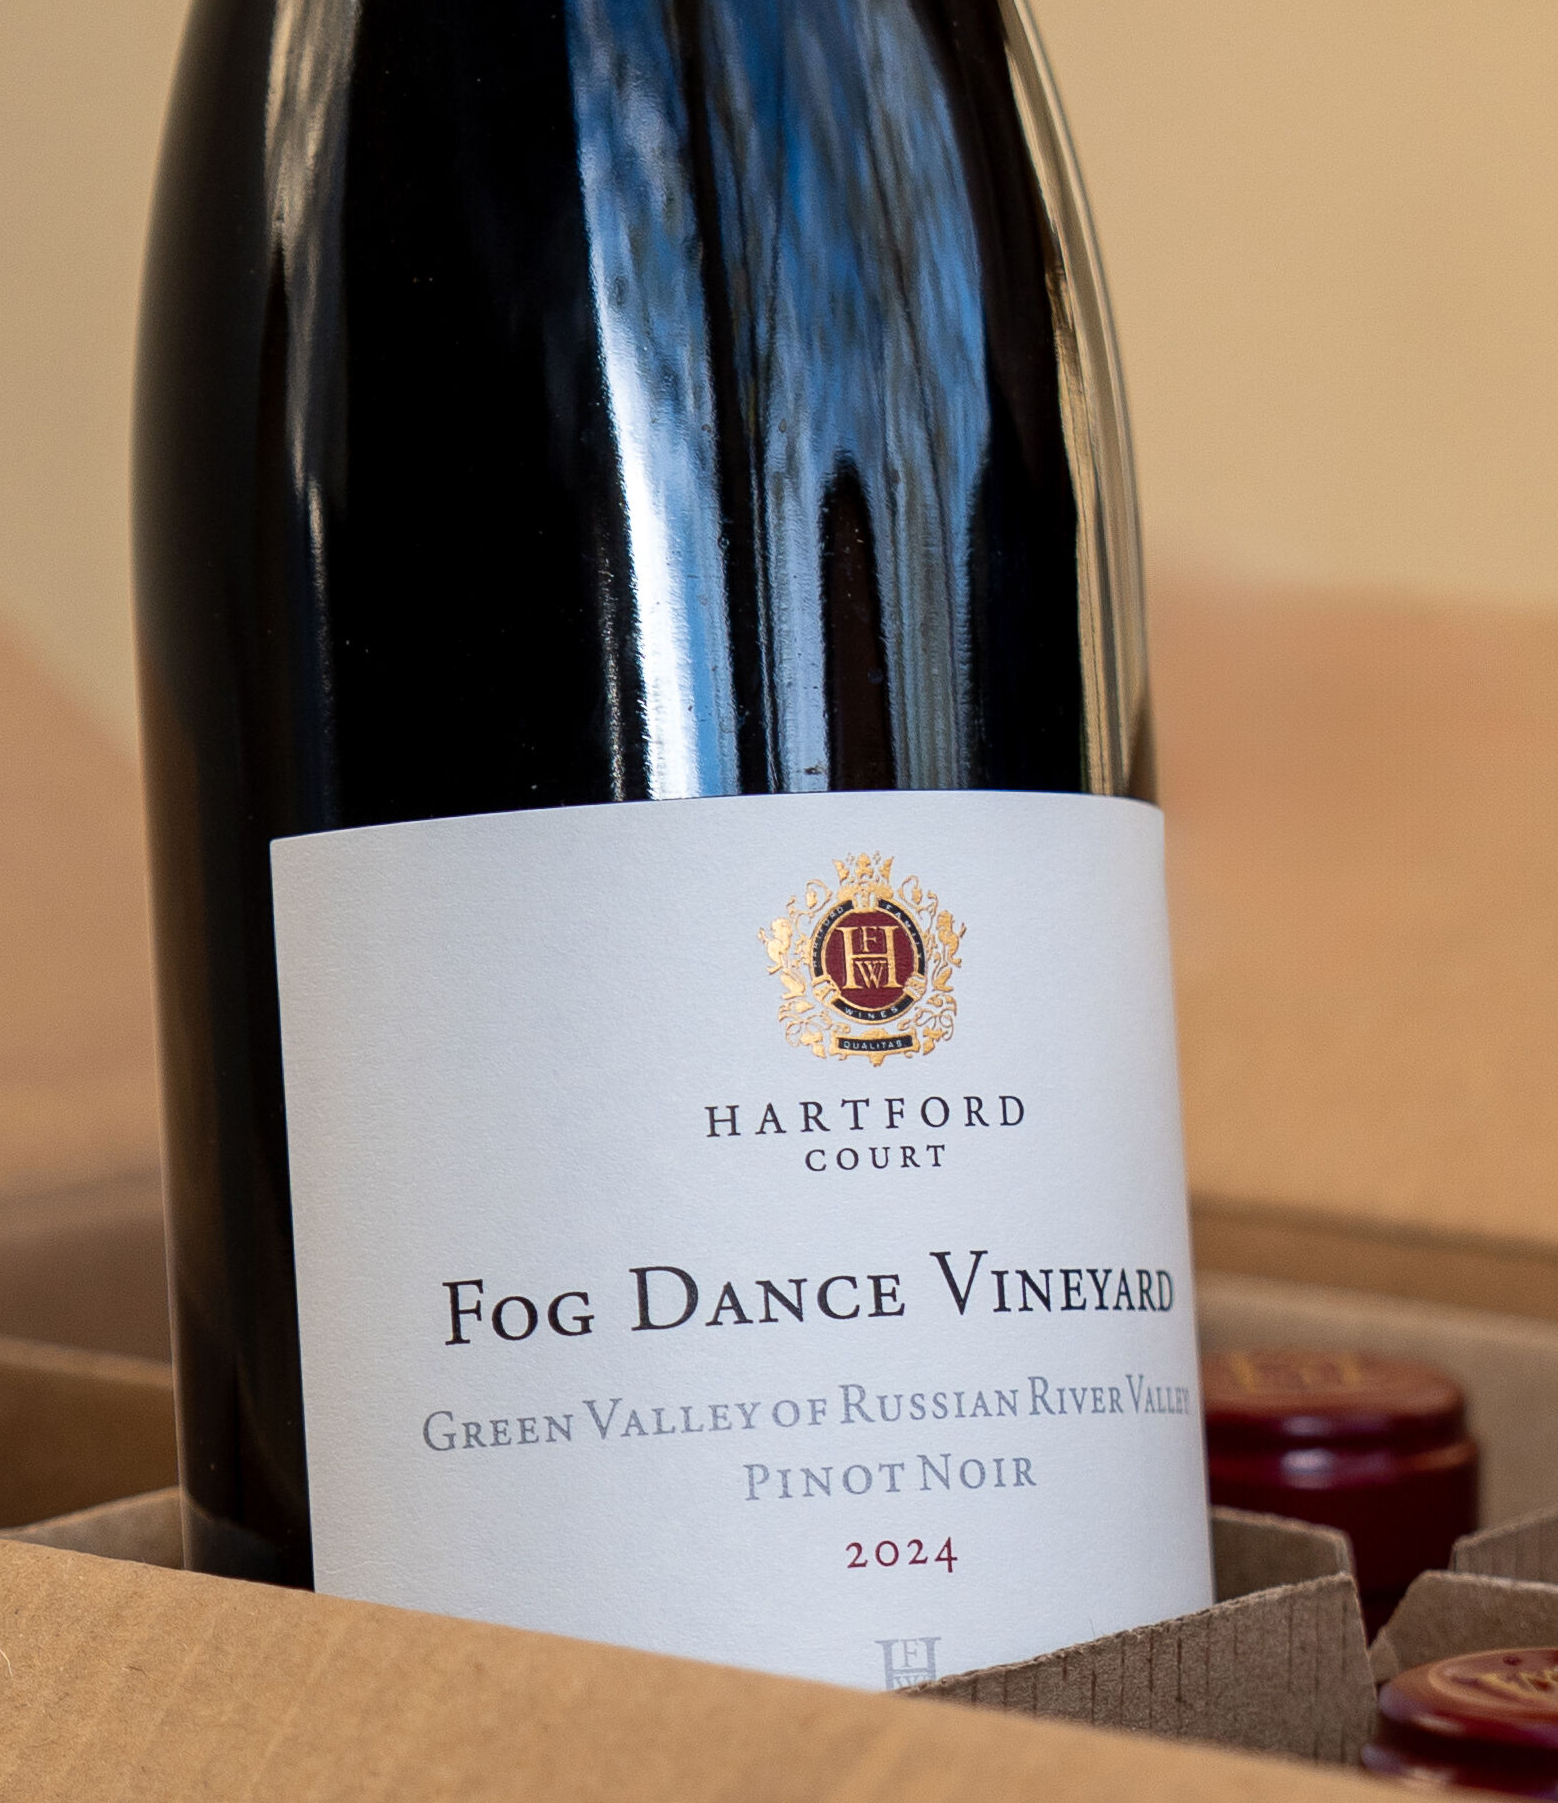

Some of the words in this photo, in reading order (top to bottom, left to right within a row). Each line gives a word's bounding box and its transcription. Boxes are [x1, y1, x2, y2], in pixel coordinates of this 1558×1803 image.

[844, 1006, 898, 1020] WINES
[704, 1095, 1025, 1138] HARTFORD
[804, 1143, 946, 1172] COURT
[442, 1278, 595, 1346] FOG
[628, 1265, 906, 1332] DANCE
[928, 1249, 1175, 1316] VINEYARD
[422, 1410, 574, 1452] GREEN
[581, 1397, 761, 1440] VALLEY
[770, 1399, 828, 1428] OF
[838, 1383, 1019, 1426] RUSSIAN
[1028, 1375, 1124, 1417] RIVER
[1125, 1373, 1190, 1415] VALLEY
[743, 1459, 905, 1502] PINOT
[916, 1453, 1038, 1493] NOIR
[845, 1536, 959, 1574] 2024
